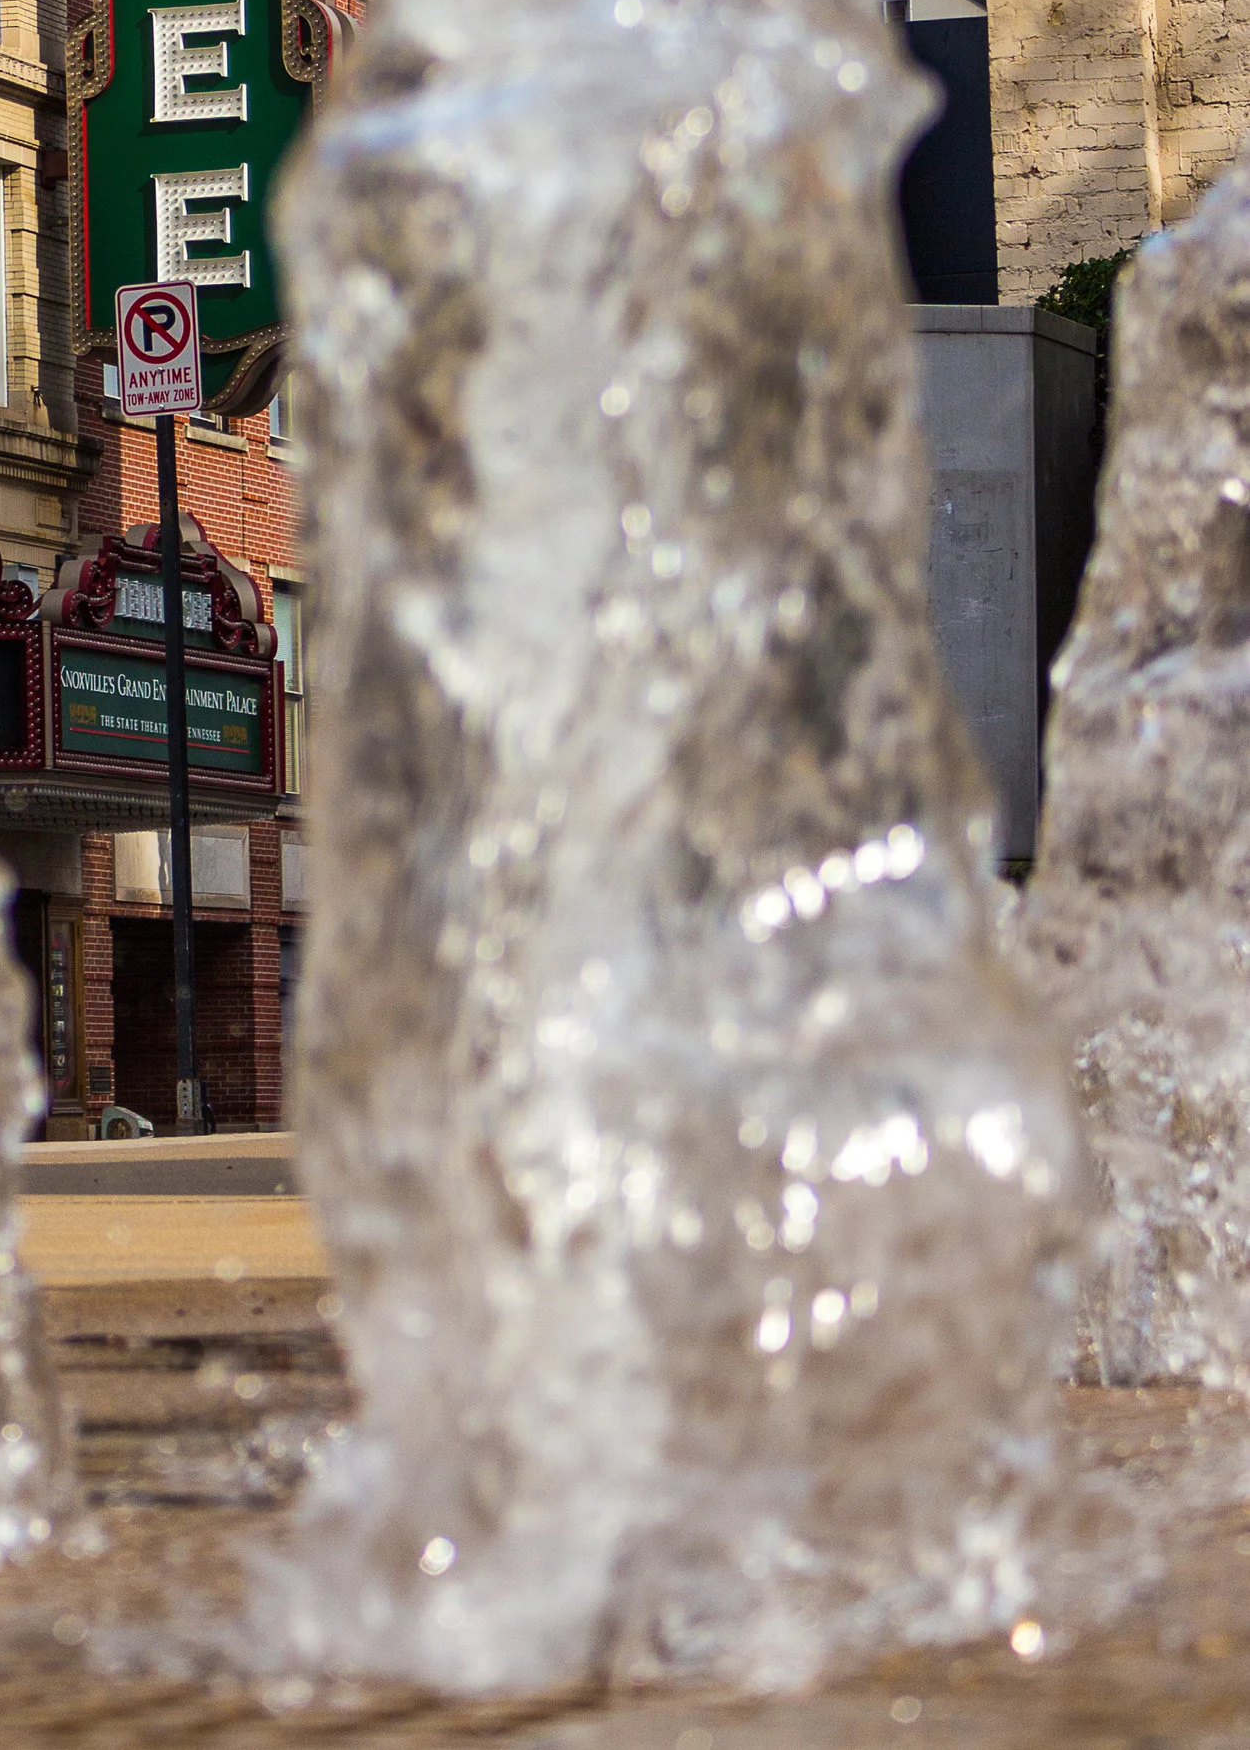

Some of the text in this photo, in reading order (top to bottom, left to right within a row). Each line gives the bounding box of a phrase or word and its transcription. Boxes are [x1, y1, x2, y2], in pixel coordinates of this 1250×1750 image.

[128, 366, 192, 389] ANYTIME
[127, 388, 195, 407] TOW-AWAY ZONE
[117, 673, 152, 699] GRAND
[226, 690, 258, 715] PALACE
[100, 714, 115, 728] THE
[116, 717, 139, 731] STATE
[140, 720, 168, 734] THEATR
